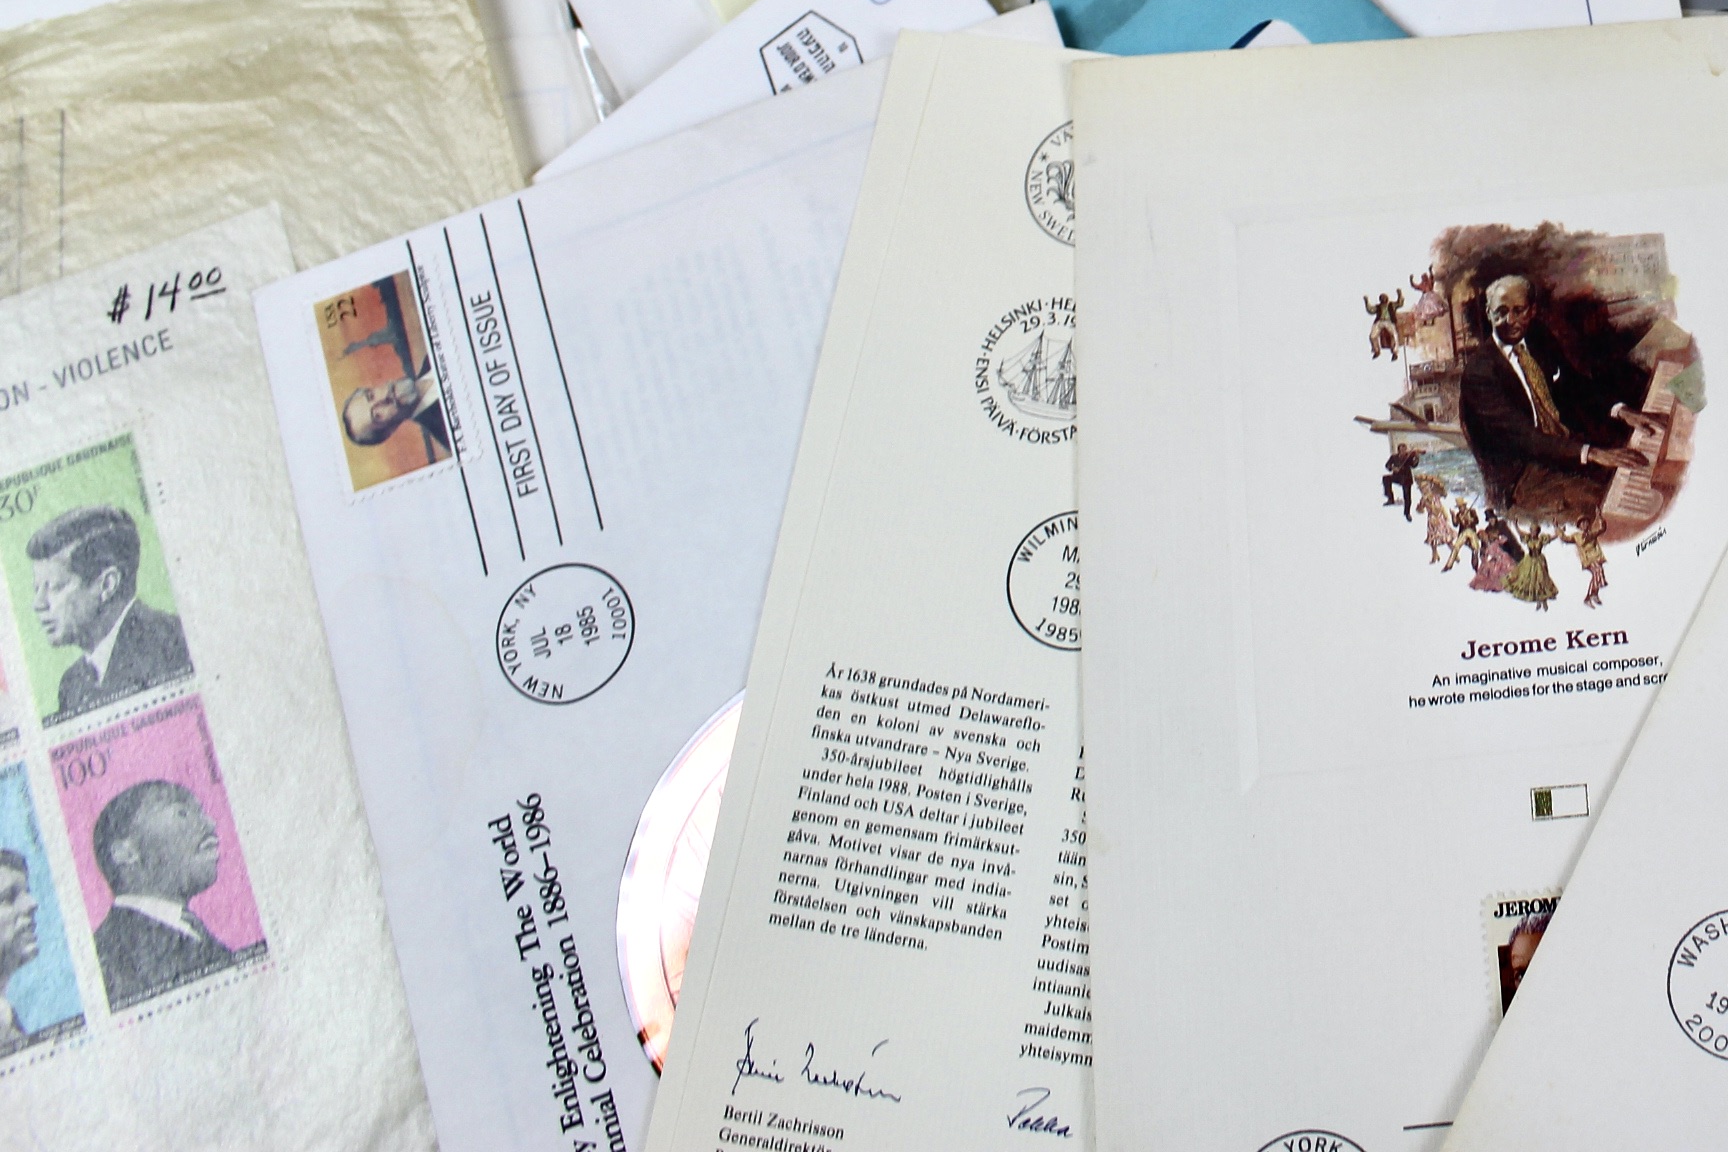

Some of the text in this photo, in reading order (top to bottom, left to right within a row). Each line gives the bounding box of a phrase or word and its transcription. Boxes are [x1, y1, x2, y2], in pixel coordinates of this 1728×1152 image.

[52, 328, 173, 387] VIOLENCE
[470, 290, 537, 497] FIRST DAY OF ISSUE
[975, 358, 1078, 446] ENSI PÄIVÄ FÖRST
[1017, 517, 1078, 563] WILMIN
[513, 582, 537, 610] NY
[602, 587, 627, 640] 10001
[530, 626, 551, 659] JUL
[554, 622, 574, 646] 18
[577, 605, 600, 646] 1985
[1459, 628, 1629, 660] Jerome Kern
[522, 674, 565, 700] NEW
[1431, 655, 1663, 688] An imaginative musical composer,
[796, 784, 1024, 836] Finland och USA deltar i jubileet
[487, 813, 584, 1134] Enlightening The World
[559, 934, 606, 1083] Celebration
